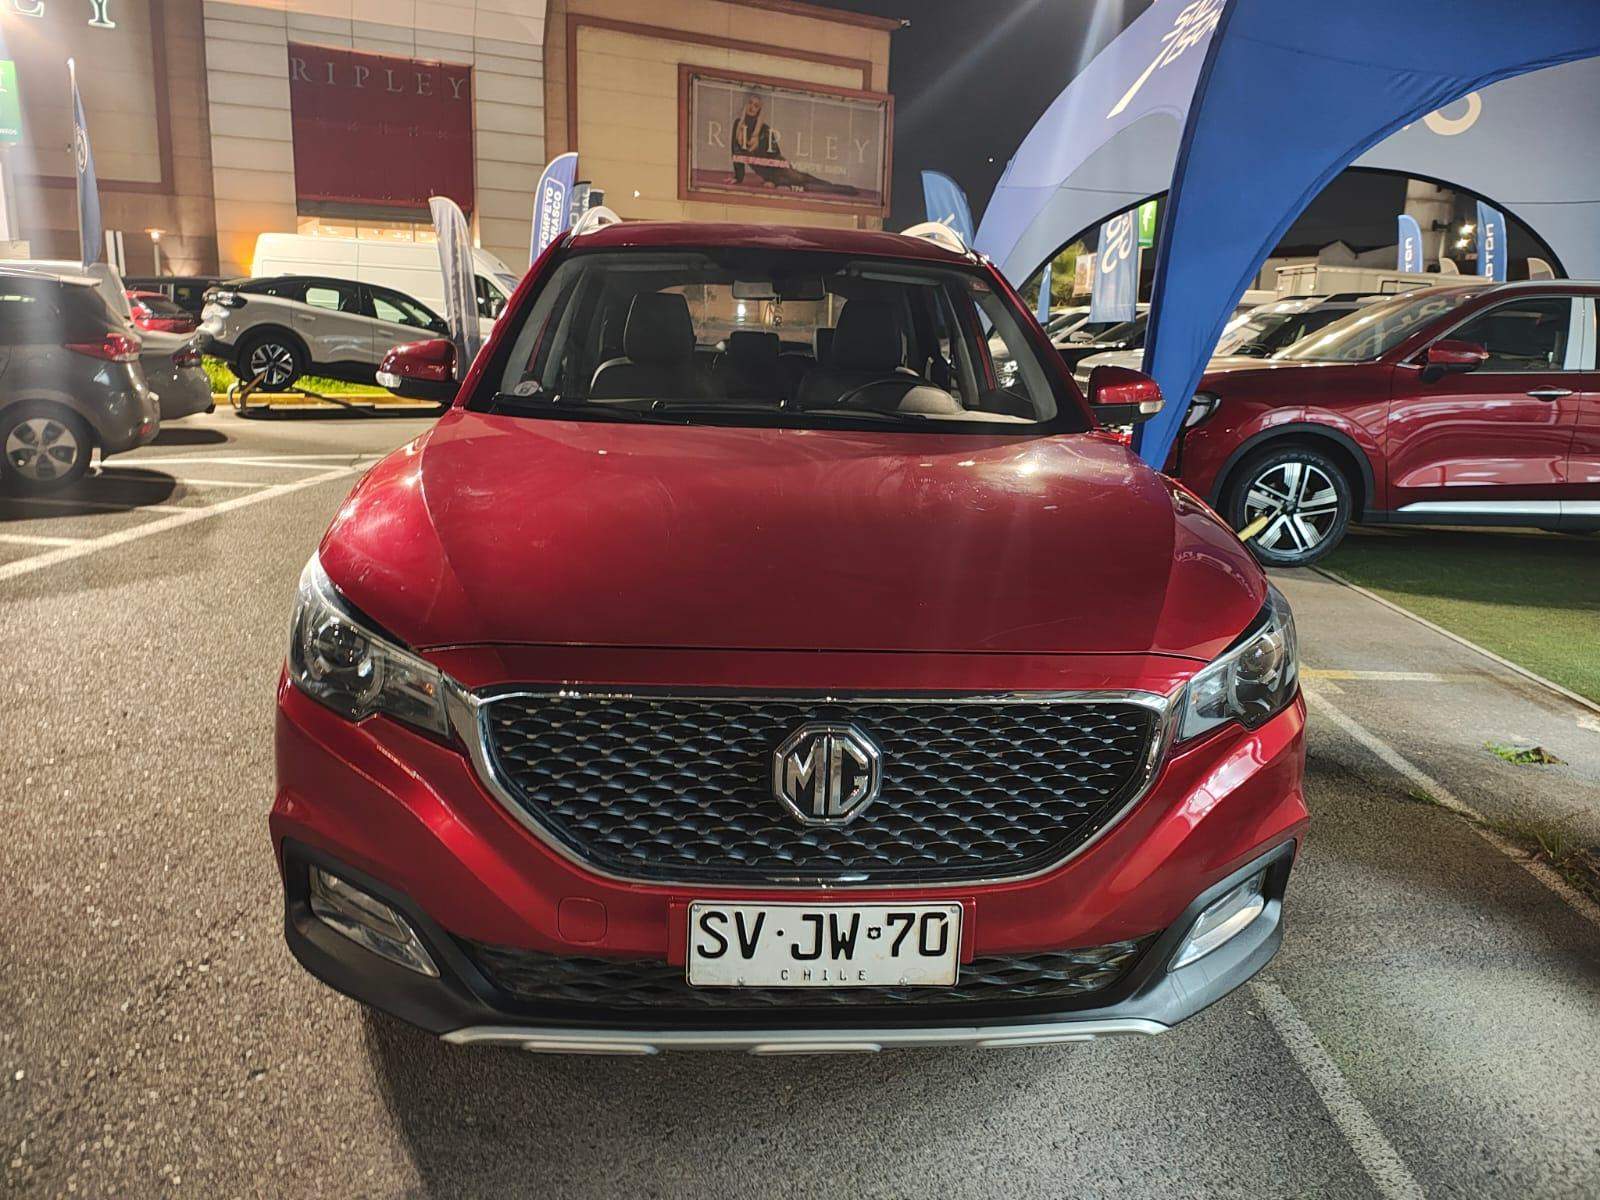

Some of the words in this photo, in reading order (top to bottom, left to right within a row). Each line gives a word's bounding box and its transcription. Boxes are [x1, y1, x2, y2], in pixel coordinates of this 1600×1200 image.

[290, 57, 464, 99] RIPLEY
[707, 120, 870, 164] RIPLEY
[541, 187, 554, 249] POMPEYO
[783, 733, 872, 818] MG
[781, 969, 867, 982] CHILE
